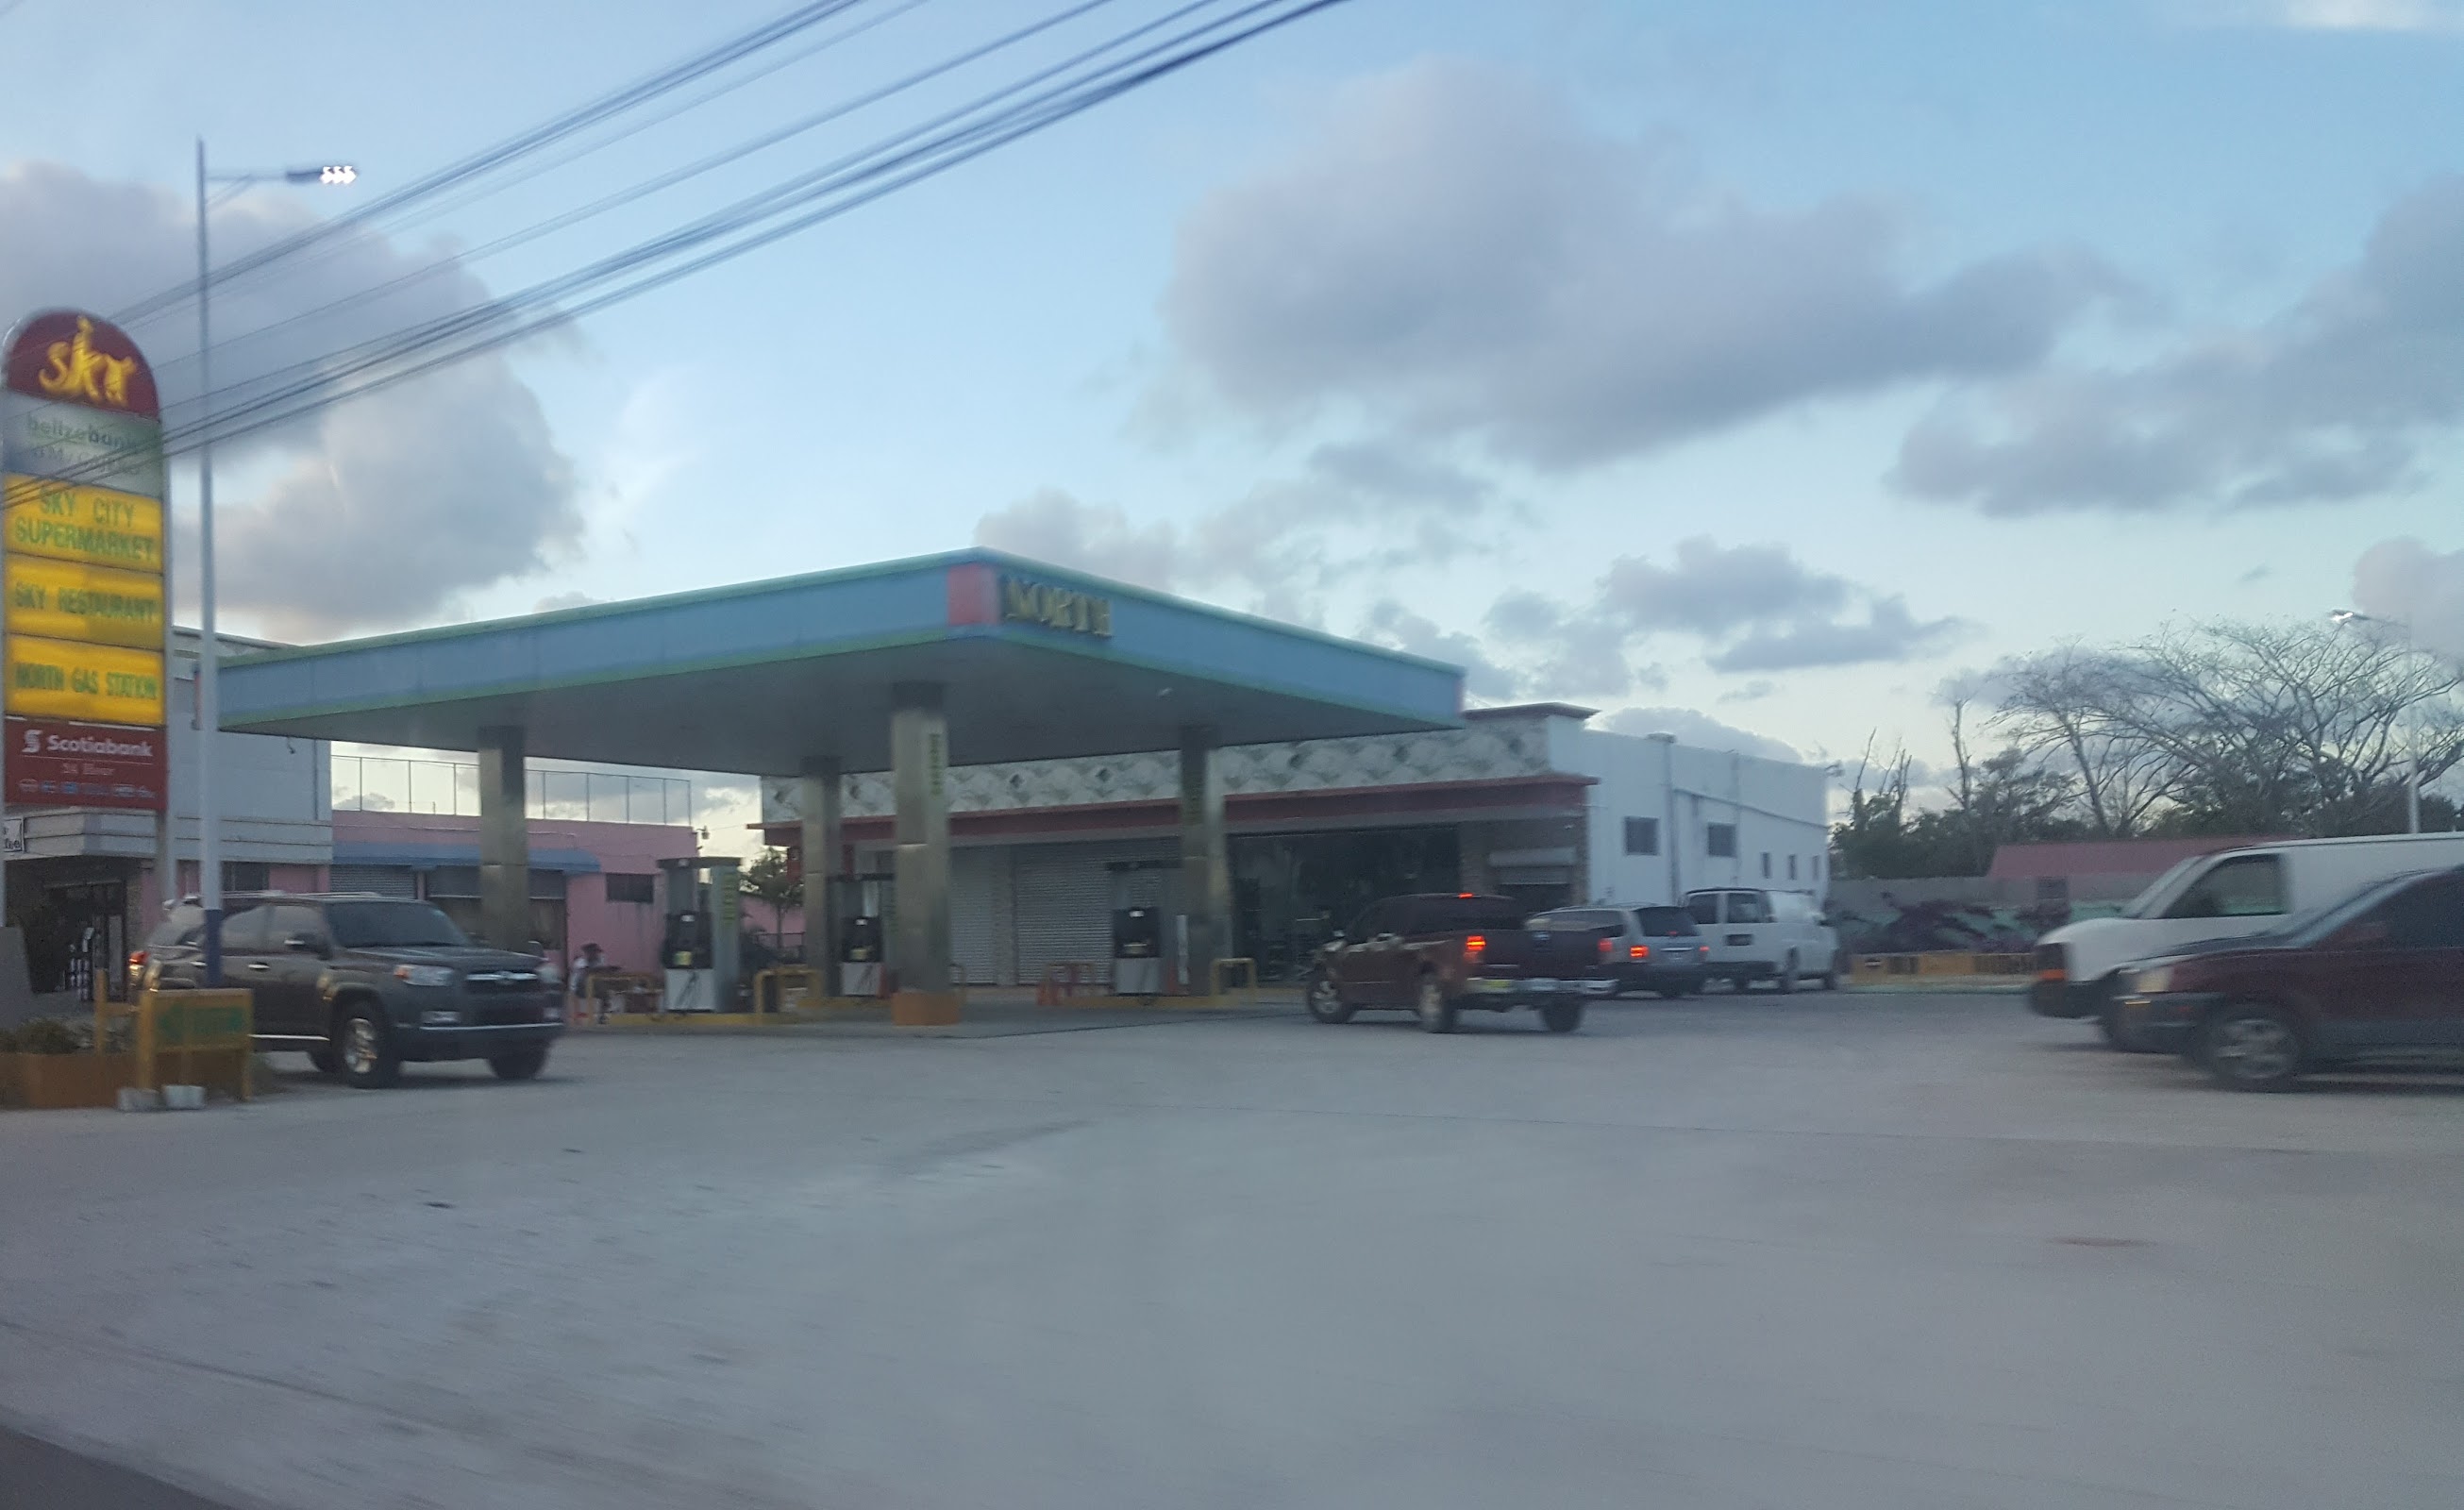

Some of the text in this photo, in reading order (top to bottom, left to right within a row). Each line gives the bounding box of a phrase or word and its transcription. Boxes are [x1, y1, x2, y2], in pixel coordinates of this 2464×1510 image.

[40, 486, 135, 528] SKY CITY
[14, 516, 155, 562] SUPERMARKET
[71, 665, 99, 695] GAS
[107, 671, 159, 700] STATION
[45, 733, 154, 757] Scotiabank
